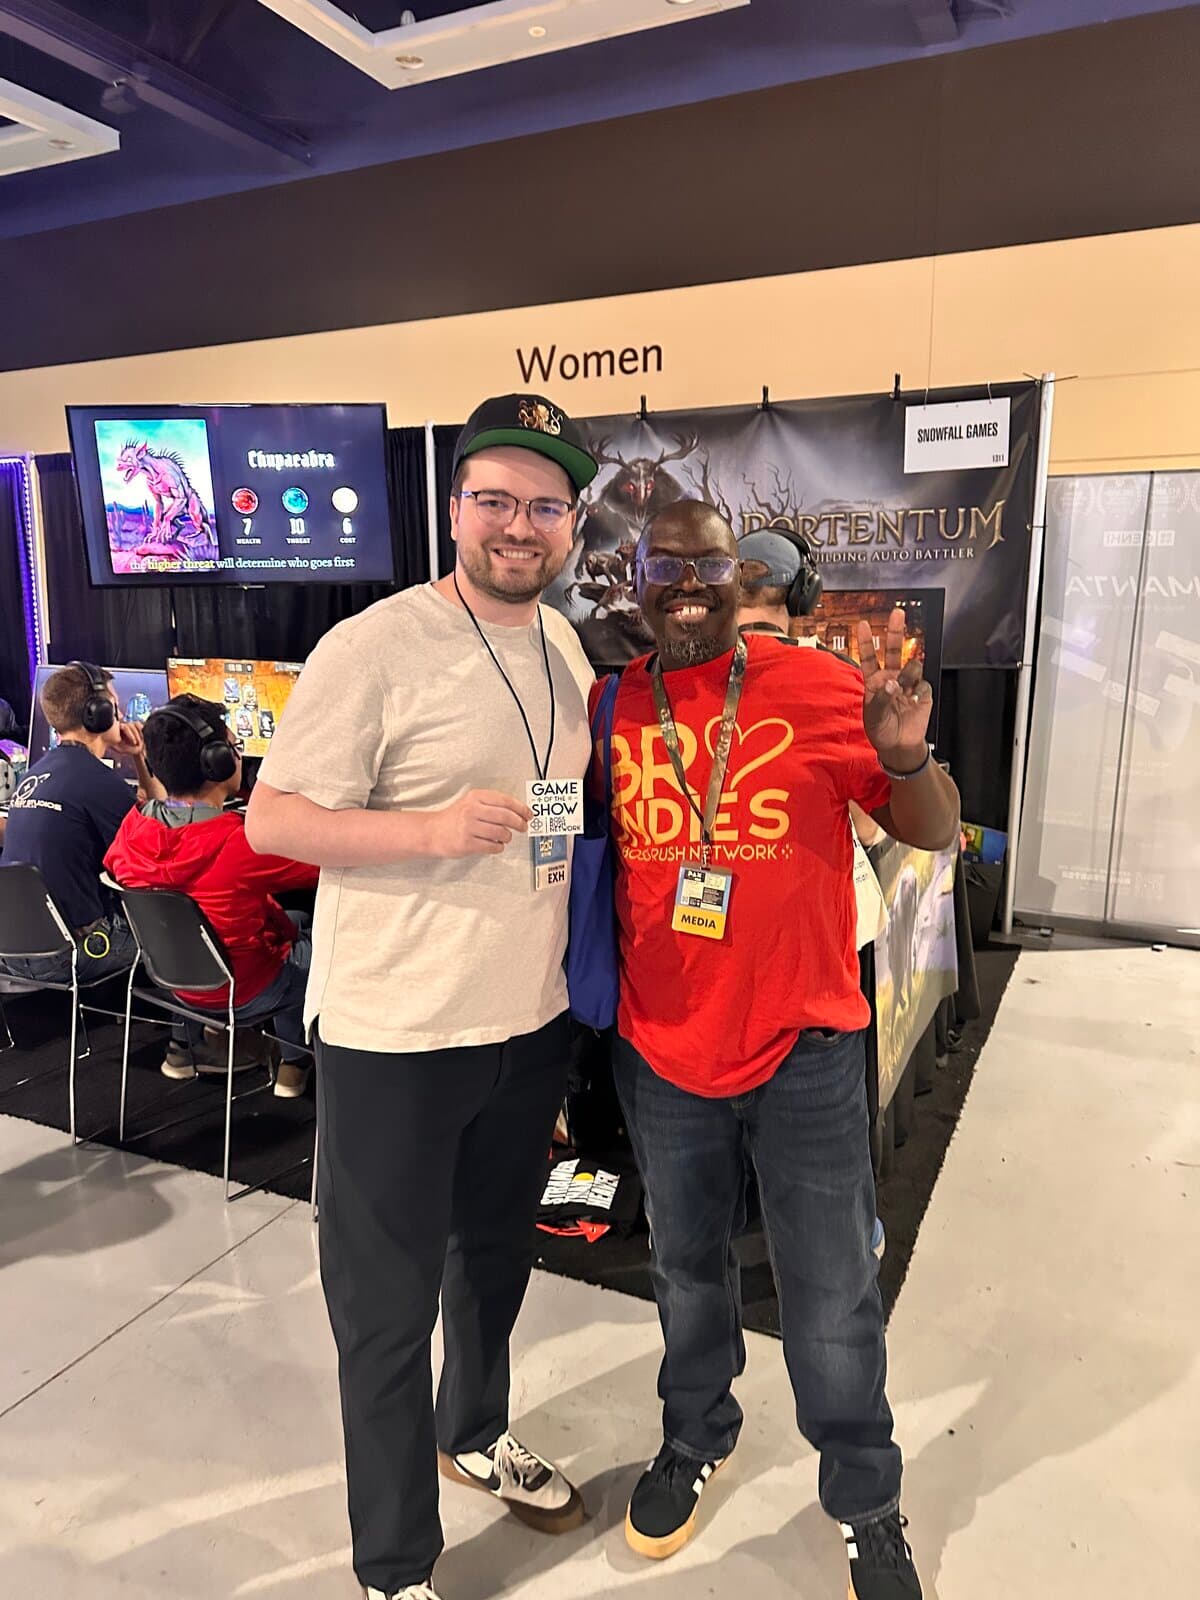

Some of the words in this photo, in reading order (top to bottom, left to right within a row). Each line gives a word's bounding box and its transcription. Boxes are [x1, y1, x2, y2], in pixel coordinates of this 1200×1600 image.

[516, 344, 662, 384] Women
[917, 425, 963, 443] SNOWFALL
[966, 422, 998, 439] GAMES
[247, 449, 335, 471] Chupacabra
[242, 518, 252, 535] 7
[289, 518, 305, 535] 10
[342, 517, 352, 534] 6
[872, 550, 910, 561] AUTO
[915, 547, 974, 560] BATTLER
[147, 558, 181, 571] higher
[183, 559, 215, 568] threat
[216, 558, 235, 568] will
[235, 557, 287, 568] determine
[287, 557, 309, 567] who
[310, 560, 333, 570] goes
[334, 556, 355, 567] first
[532, 782, 578, 795] GAME
[532, 802, 578, 816] SHOW
[689, 844, 777, 860] NTWORK
[548, 870, 565, 884] EXH
[681, 914, 716, 929] MEDIA
